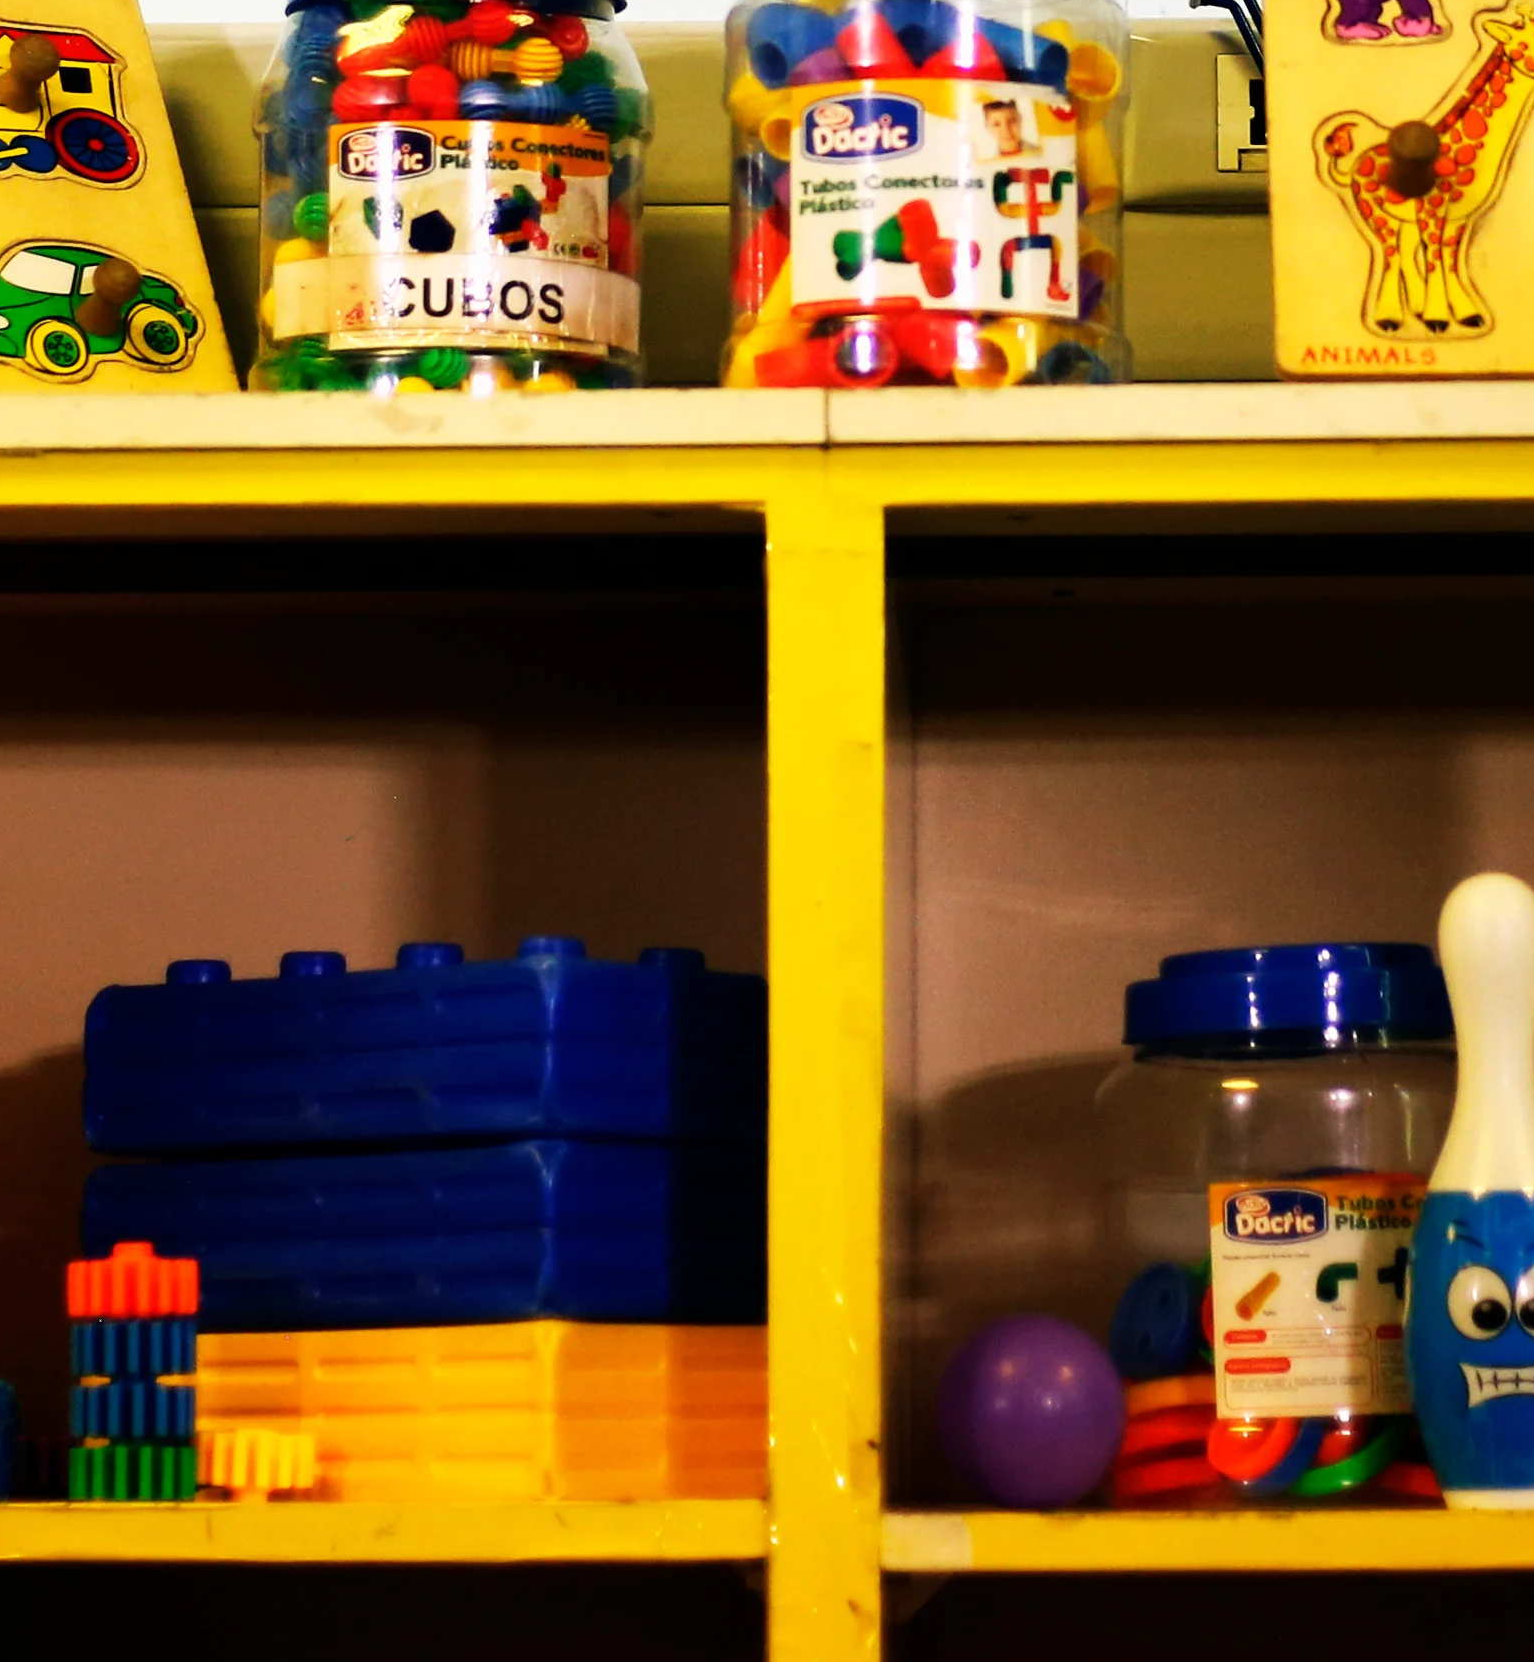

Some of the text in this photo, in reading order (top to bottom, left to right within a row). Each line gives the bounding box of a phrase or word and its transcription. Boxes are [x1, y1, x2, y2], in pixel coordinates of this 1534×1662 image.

[348, 143, 424, 175] Datic
[440, 135, 504, 152] Cuos
[440, 152, 519, 171] Plático
[800, 177, 856, 195] Tubos
[382, 277, 565, 324] CUBOS
[1301, 345, 1438, 366] ANIMALS
[1336, 1196, 1396, 1212] Tubos
[1235, 1205, 1315, 1235] Dactic
